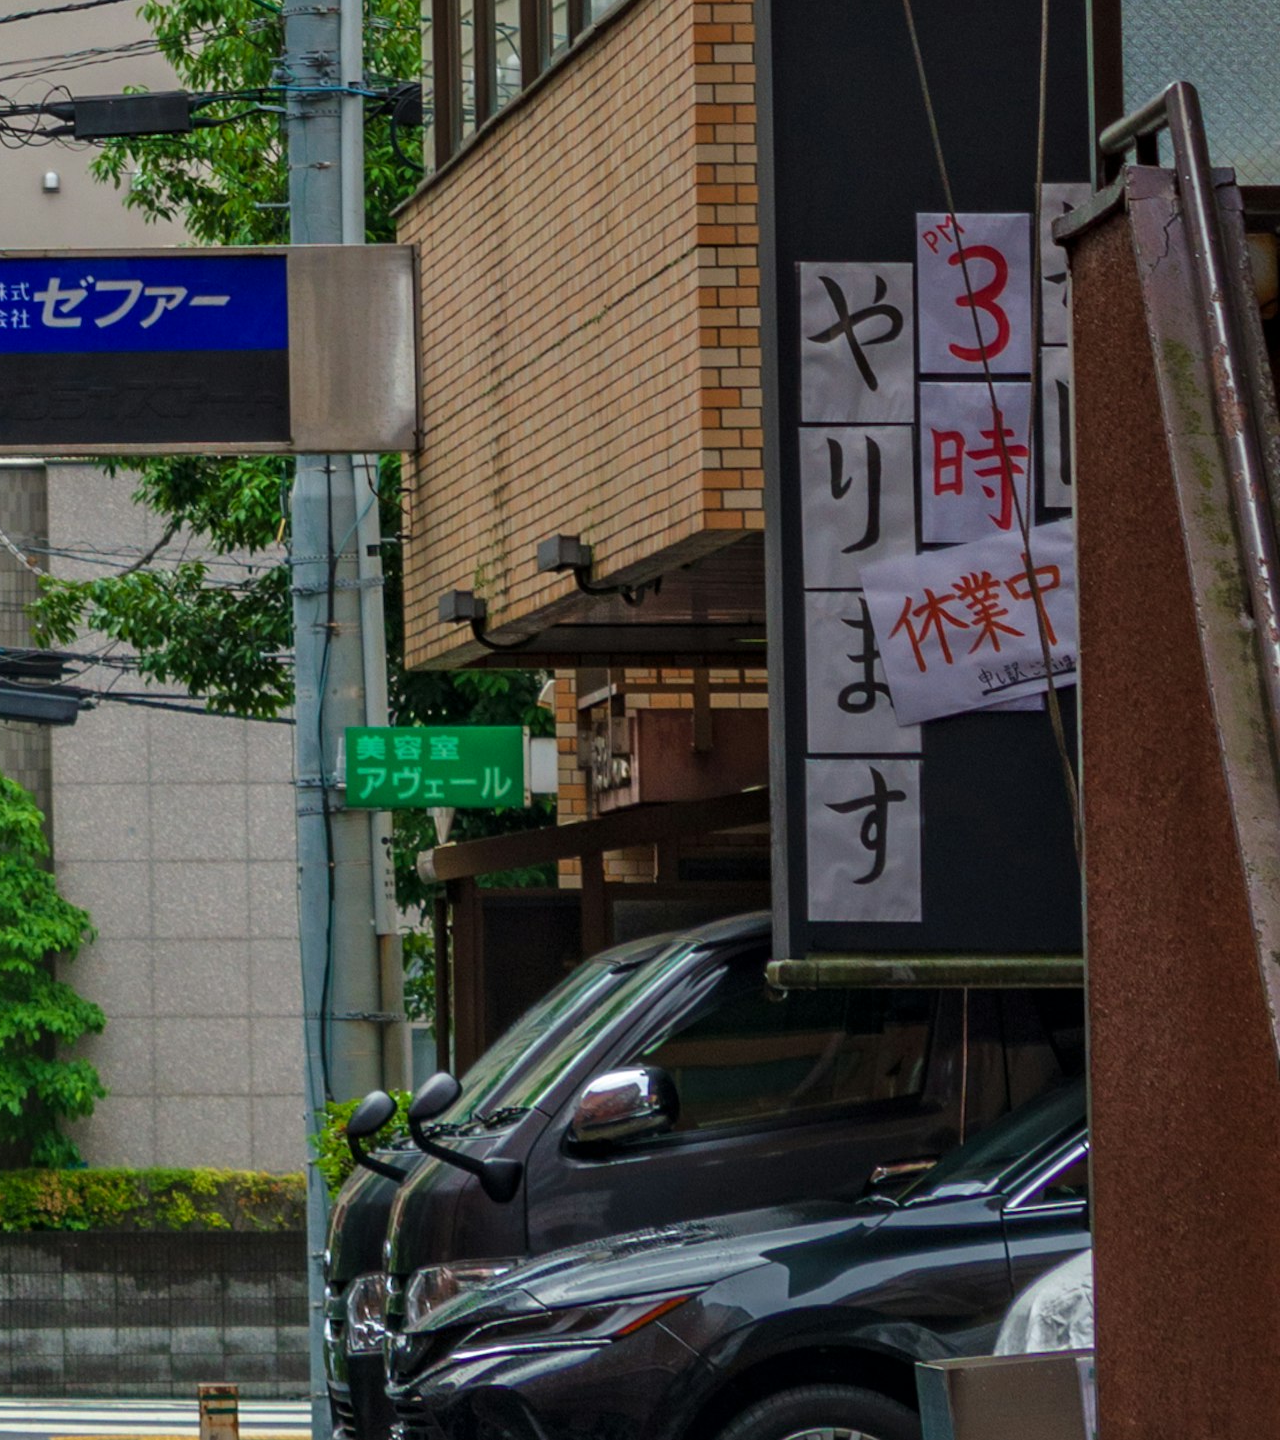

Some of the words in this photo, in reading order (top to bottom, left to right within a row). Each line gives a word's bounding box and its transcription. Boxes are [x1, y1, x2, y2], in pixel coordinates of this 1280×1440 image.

[922, 214, 966, 255] PM
[32, 275, 231, 329] ゼファー
[887, 551, 1062, 673] 休業中
[356, 735, 460, 761] 美容室
[356, 765, 513, 800] アヴェール
